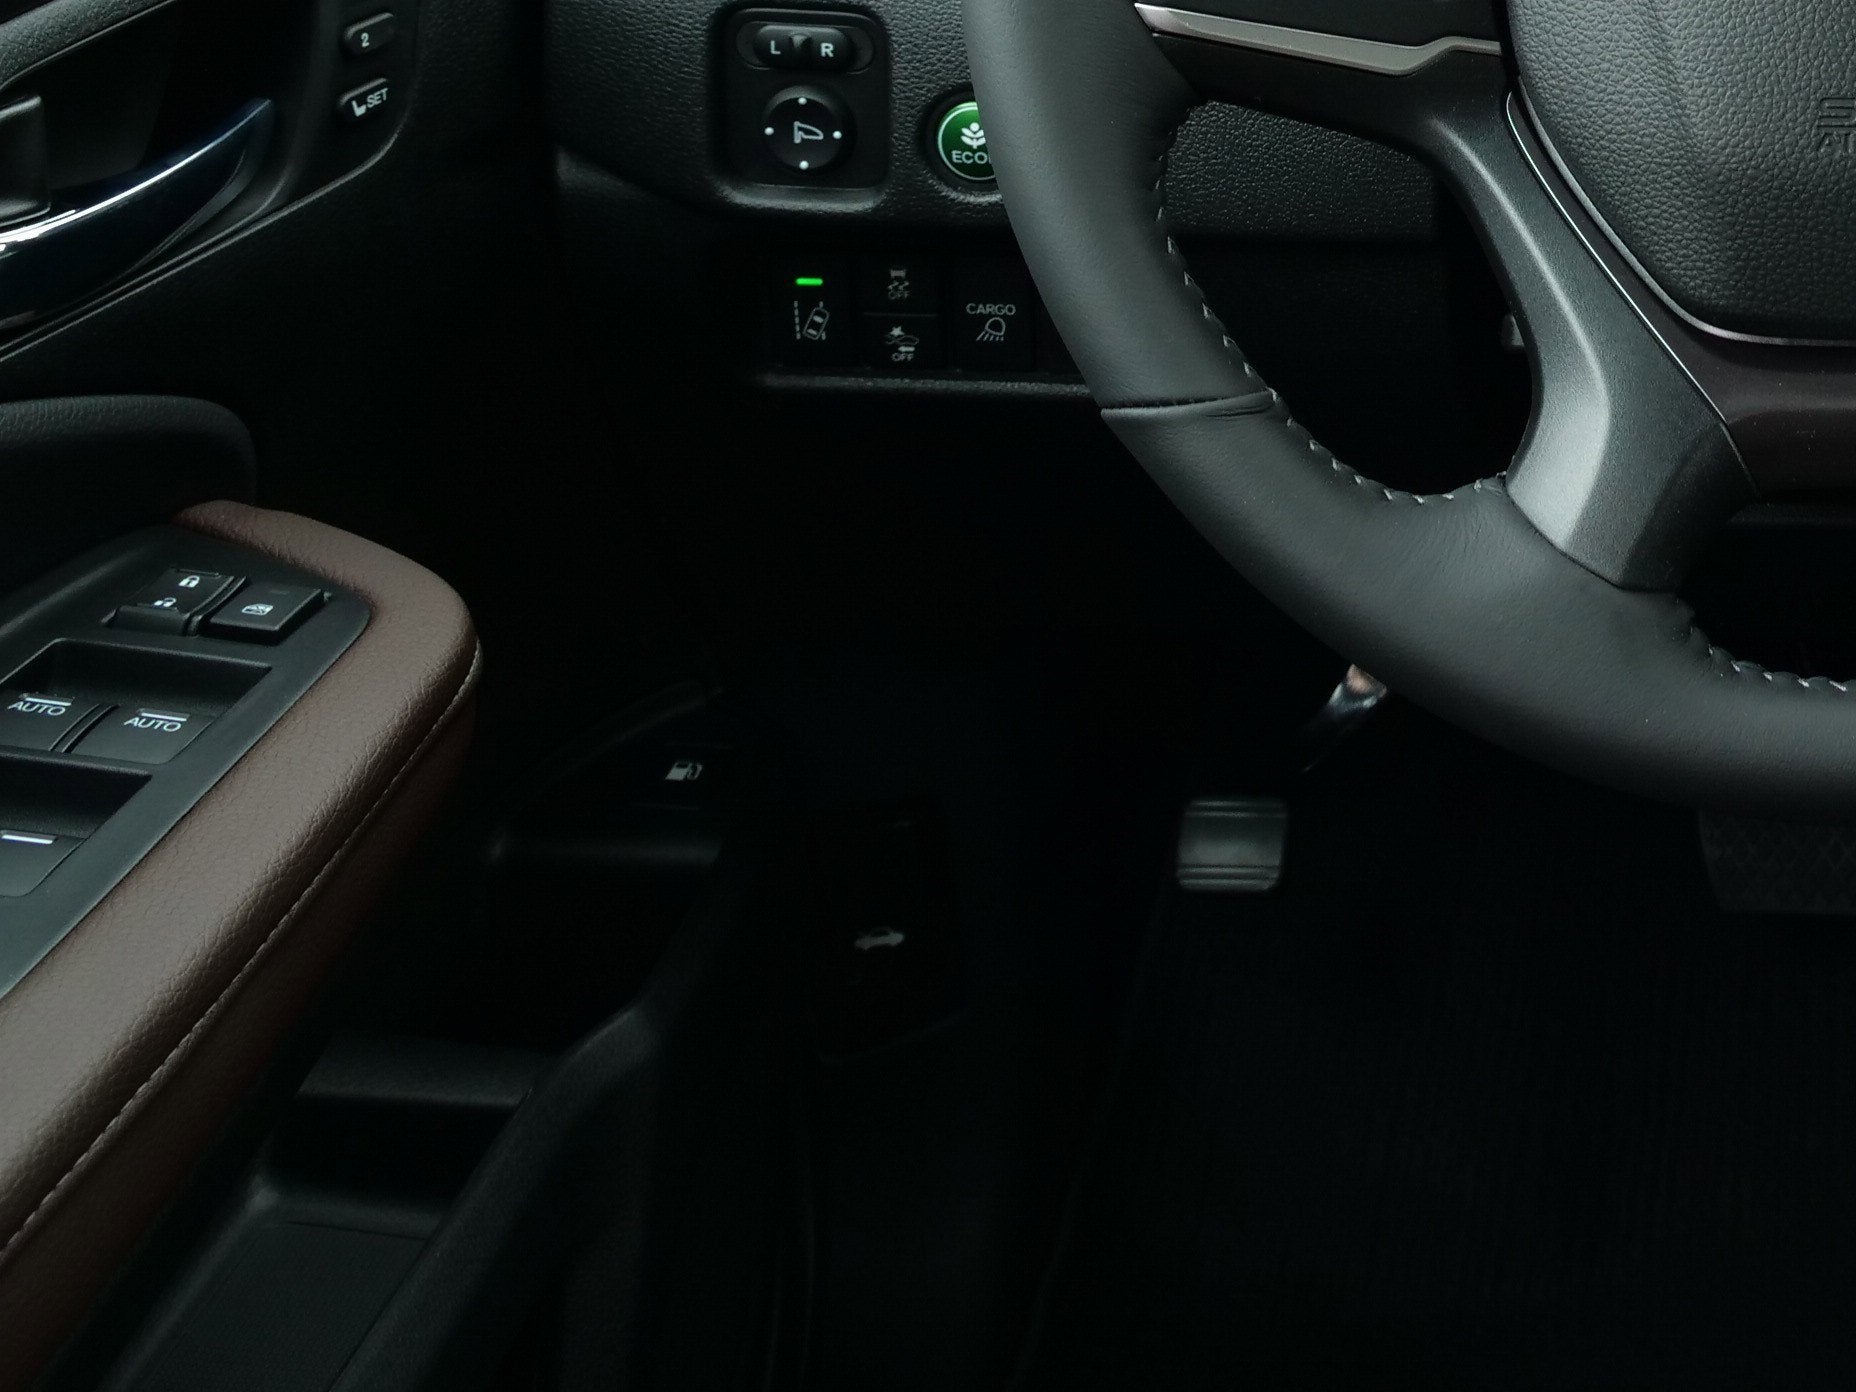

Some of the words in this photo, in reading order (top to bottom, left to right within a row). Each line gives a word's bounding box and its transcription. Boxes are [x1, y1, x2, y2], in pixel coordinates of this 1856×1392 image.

[360, 32, 370, 48] 2
[769, 40, 781, 55] L
[820, 42, 834, 58] R
[366, 88, 389, 109] SET
[965, 303, 1017, 316] CARGO
[891, 352, 915, 362] OFF
[8, 701, 66, 716] AUTO
[124, 715, 182, 732] AUTO
